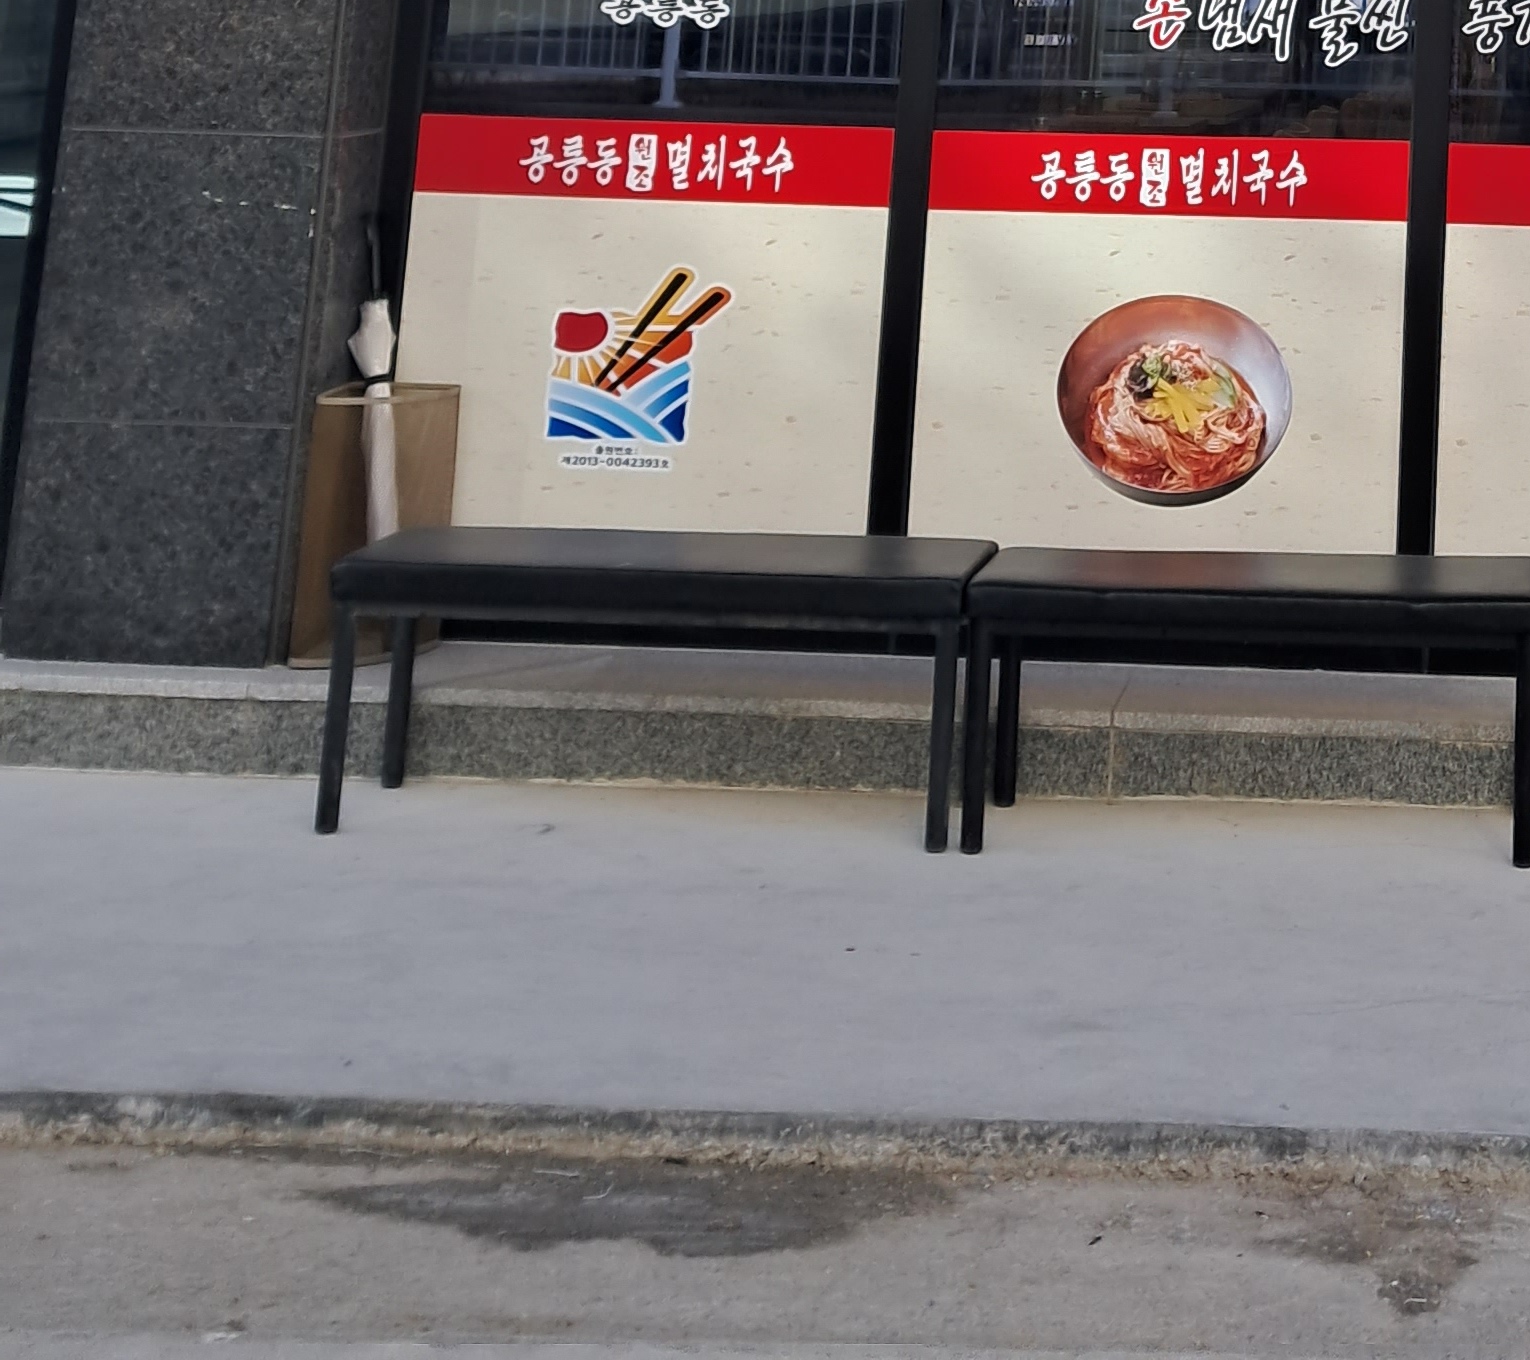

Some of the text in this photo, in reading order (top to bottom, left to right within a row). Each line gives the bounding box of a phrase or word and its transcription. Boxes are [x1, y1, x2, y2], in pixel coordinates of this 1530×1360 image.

[519, 135, 622, 186] 공릉동
[666, 133, 794, 193] 멸치국수
[1031, 150, 1135, 202] 공릉동
[1180, 147, 1308, 208] 멸치국수
